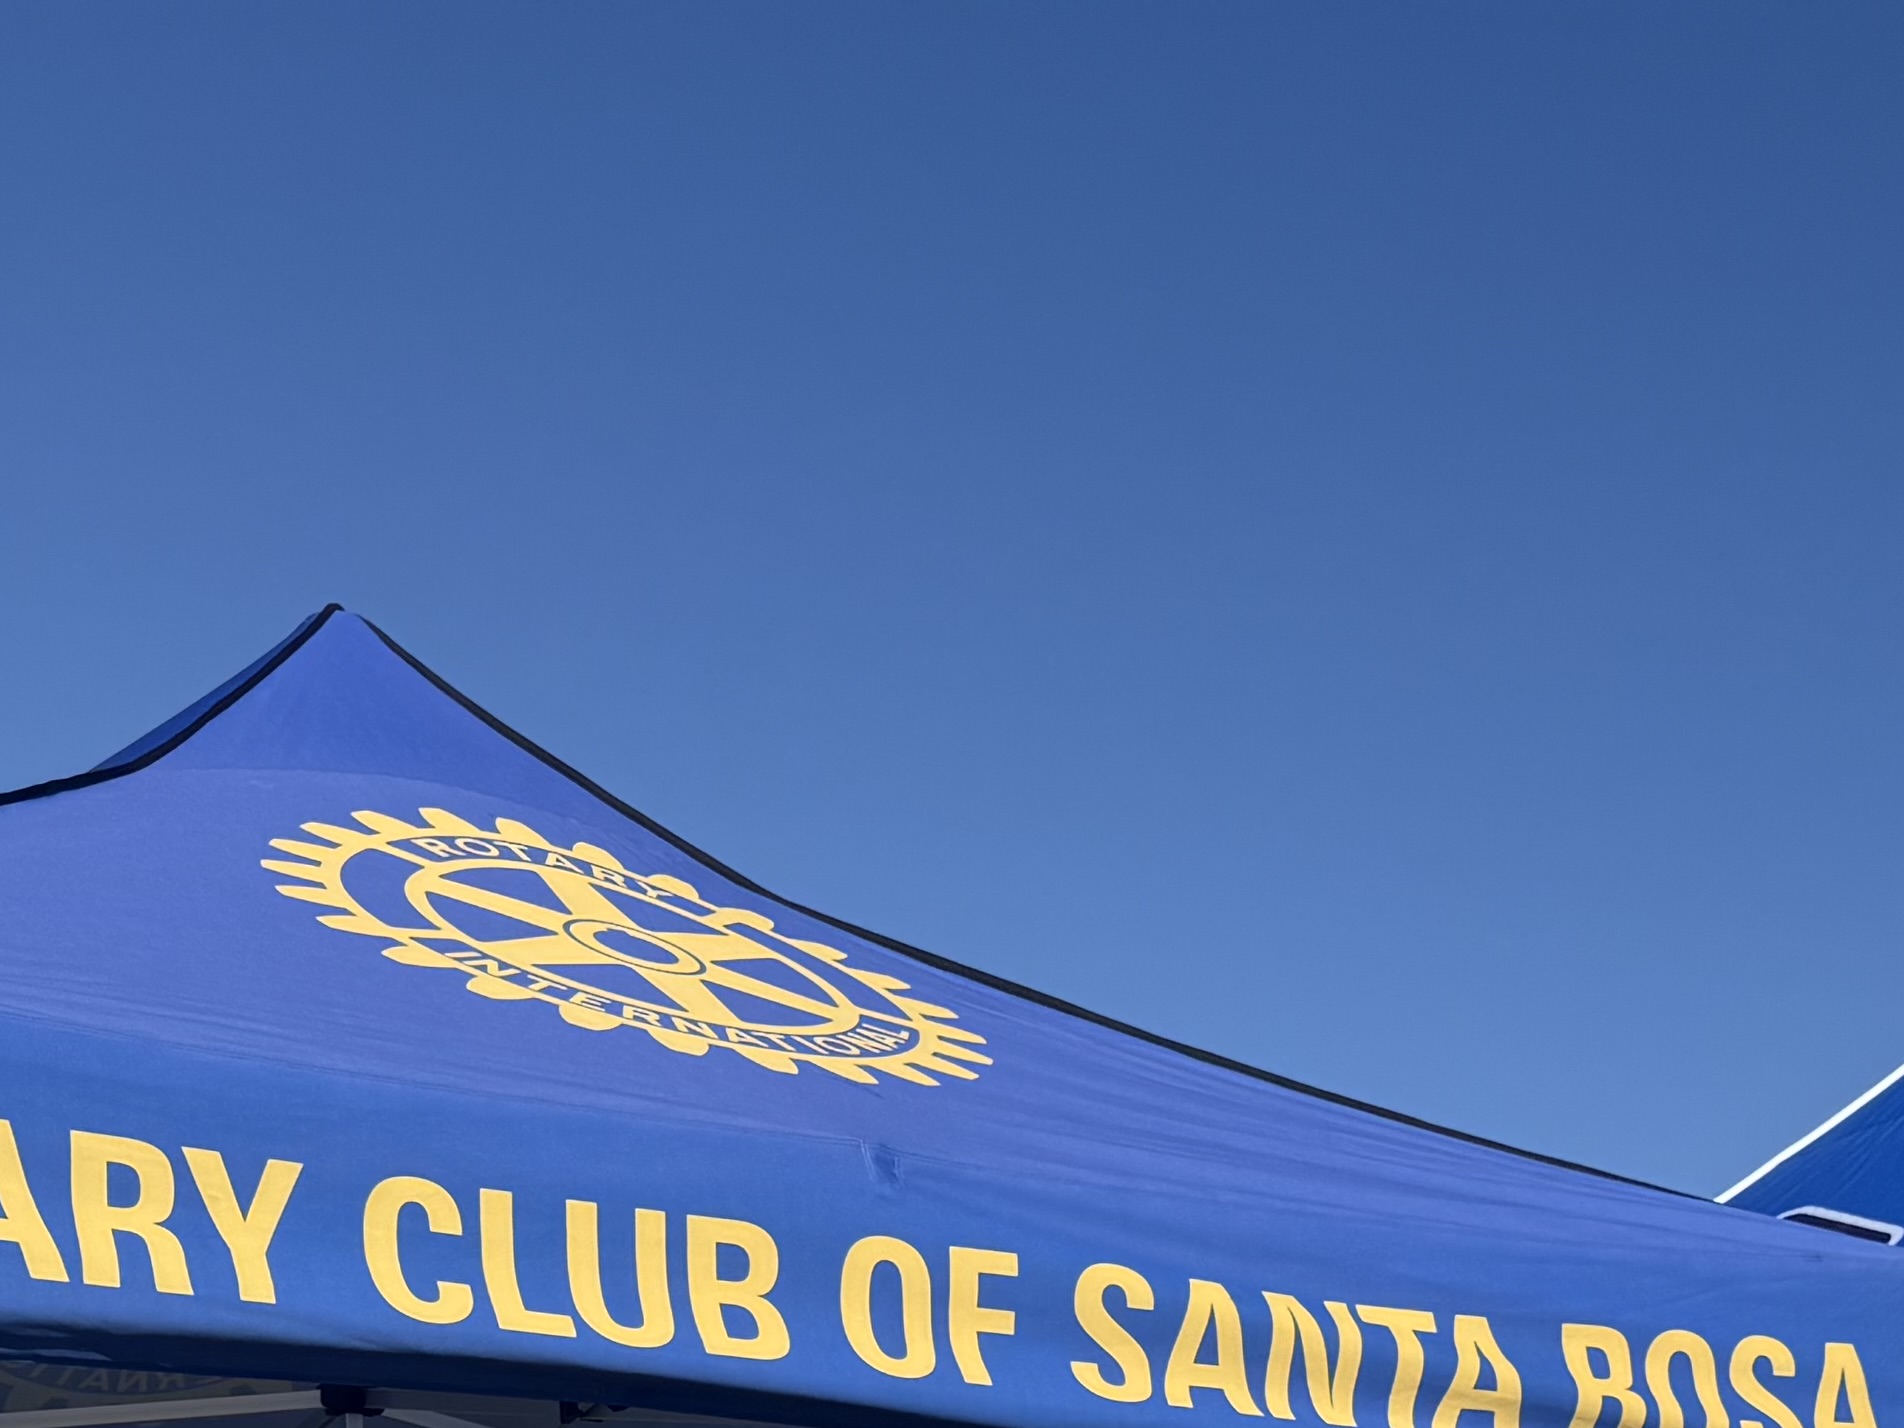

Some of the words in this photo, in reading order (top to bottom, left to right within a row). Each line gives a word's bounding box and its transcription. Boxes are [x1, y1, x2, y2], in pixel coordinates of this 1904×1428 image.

[416, 836, 674, 901] ROTARY
[446, 951, 910, 1056] INTERNATIONAL
[362, 1174, 792, 1361] CLUB
[840, 1234, 1017, 1386] OF
